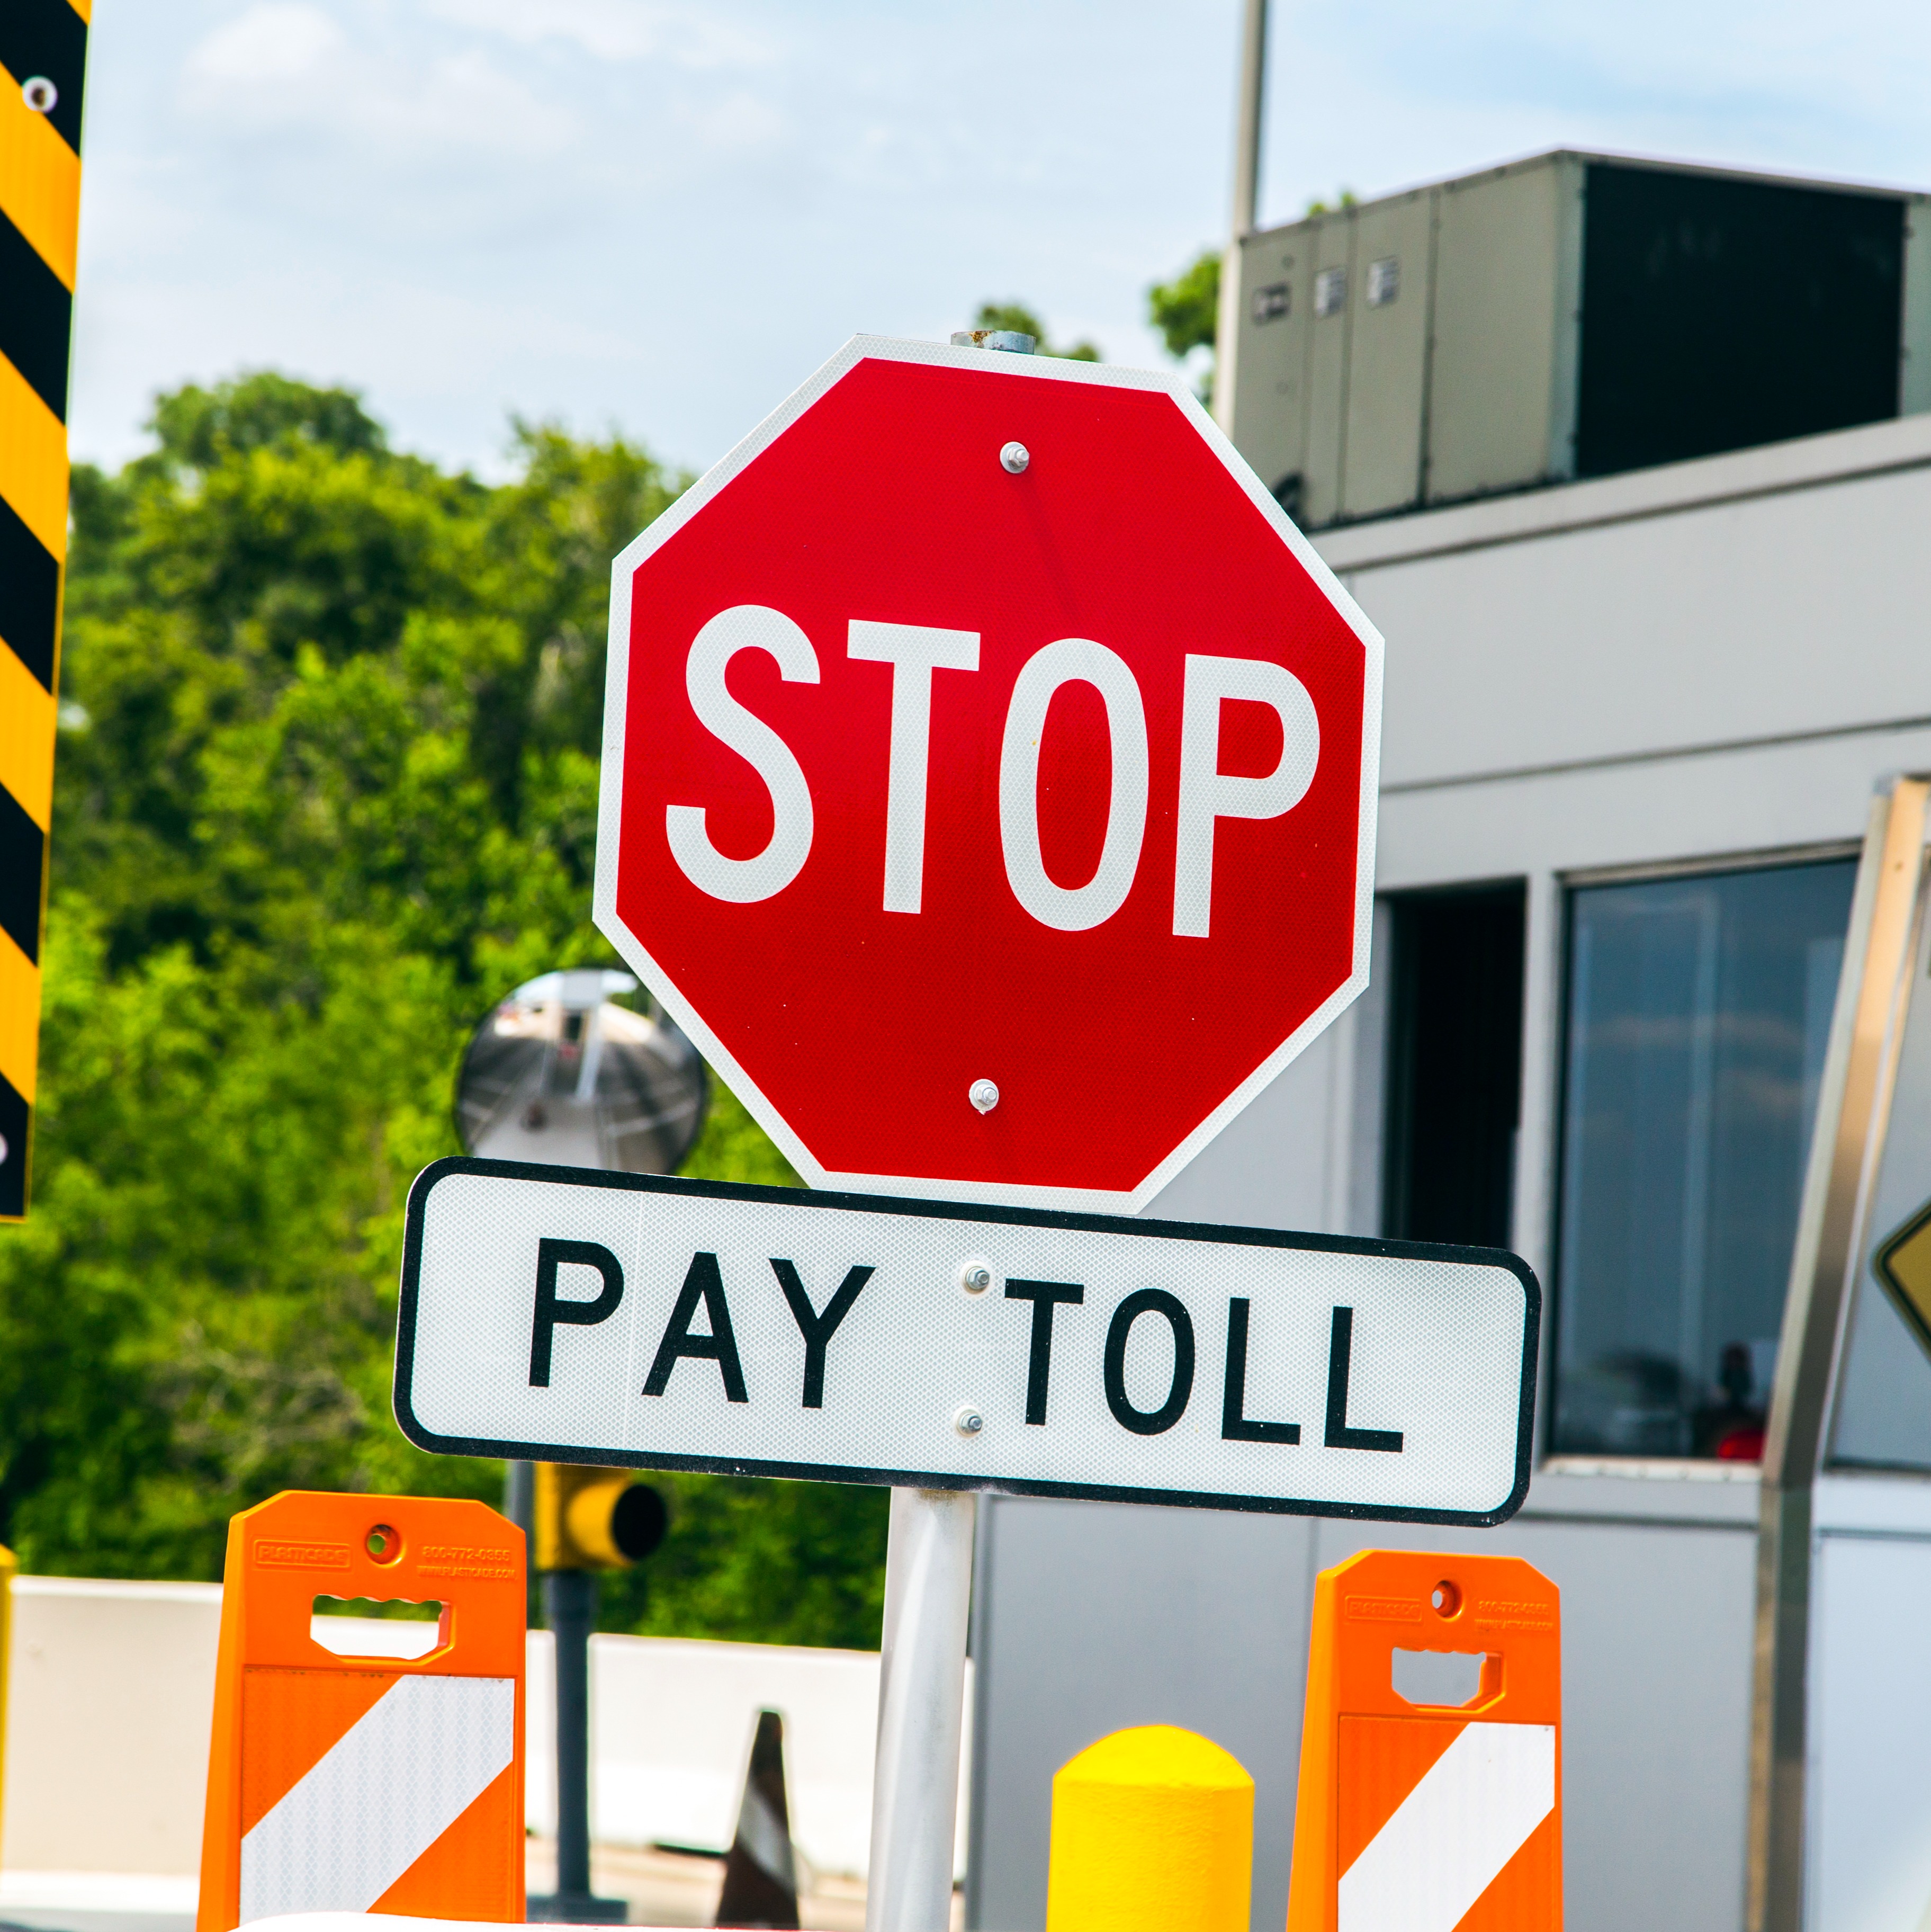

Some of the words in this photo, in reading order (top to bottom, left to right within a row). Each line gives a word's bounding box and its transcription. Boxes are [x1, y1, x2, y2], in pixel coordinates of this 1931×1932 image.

[666, 605, 1319, 937] STOP
[529, 1238, 876, 1408] PAY
[1005, 1279, 1403, 1452] TOLL
[422, 1546, 511, 1562] 800-772-0355
